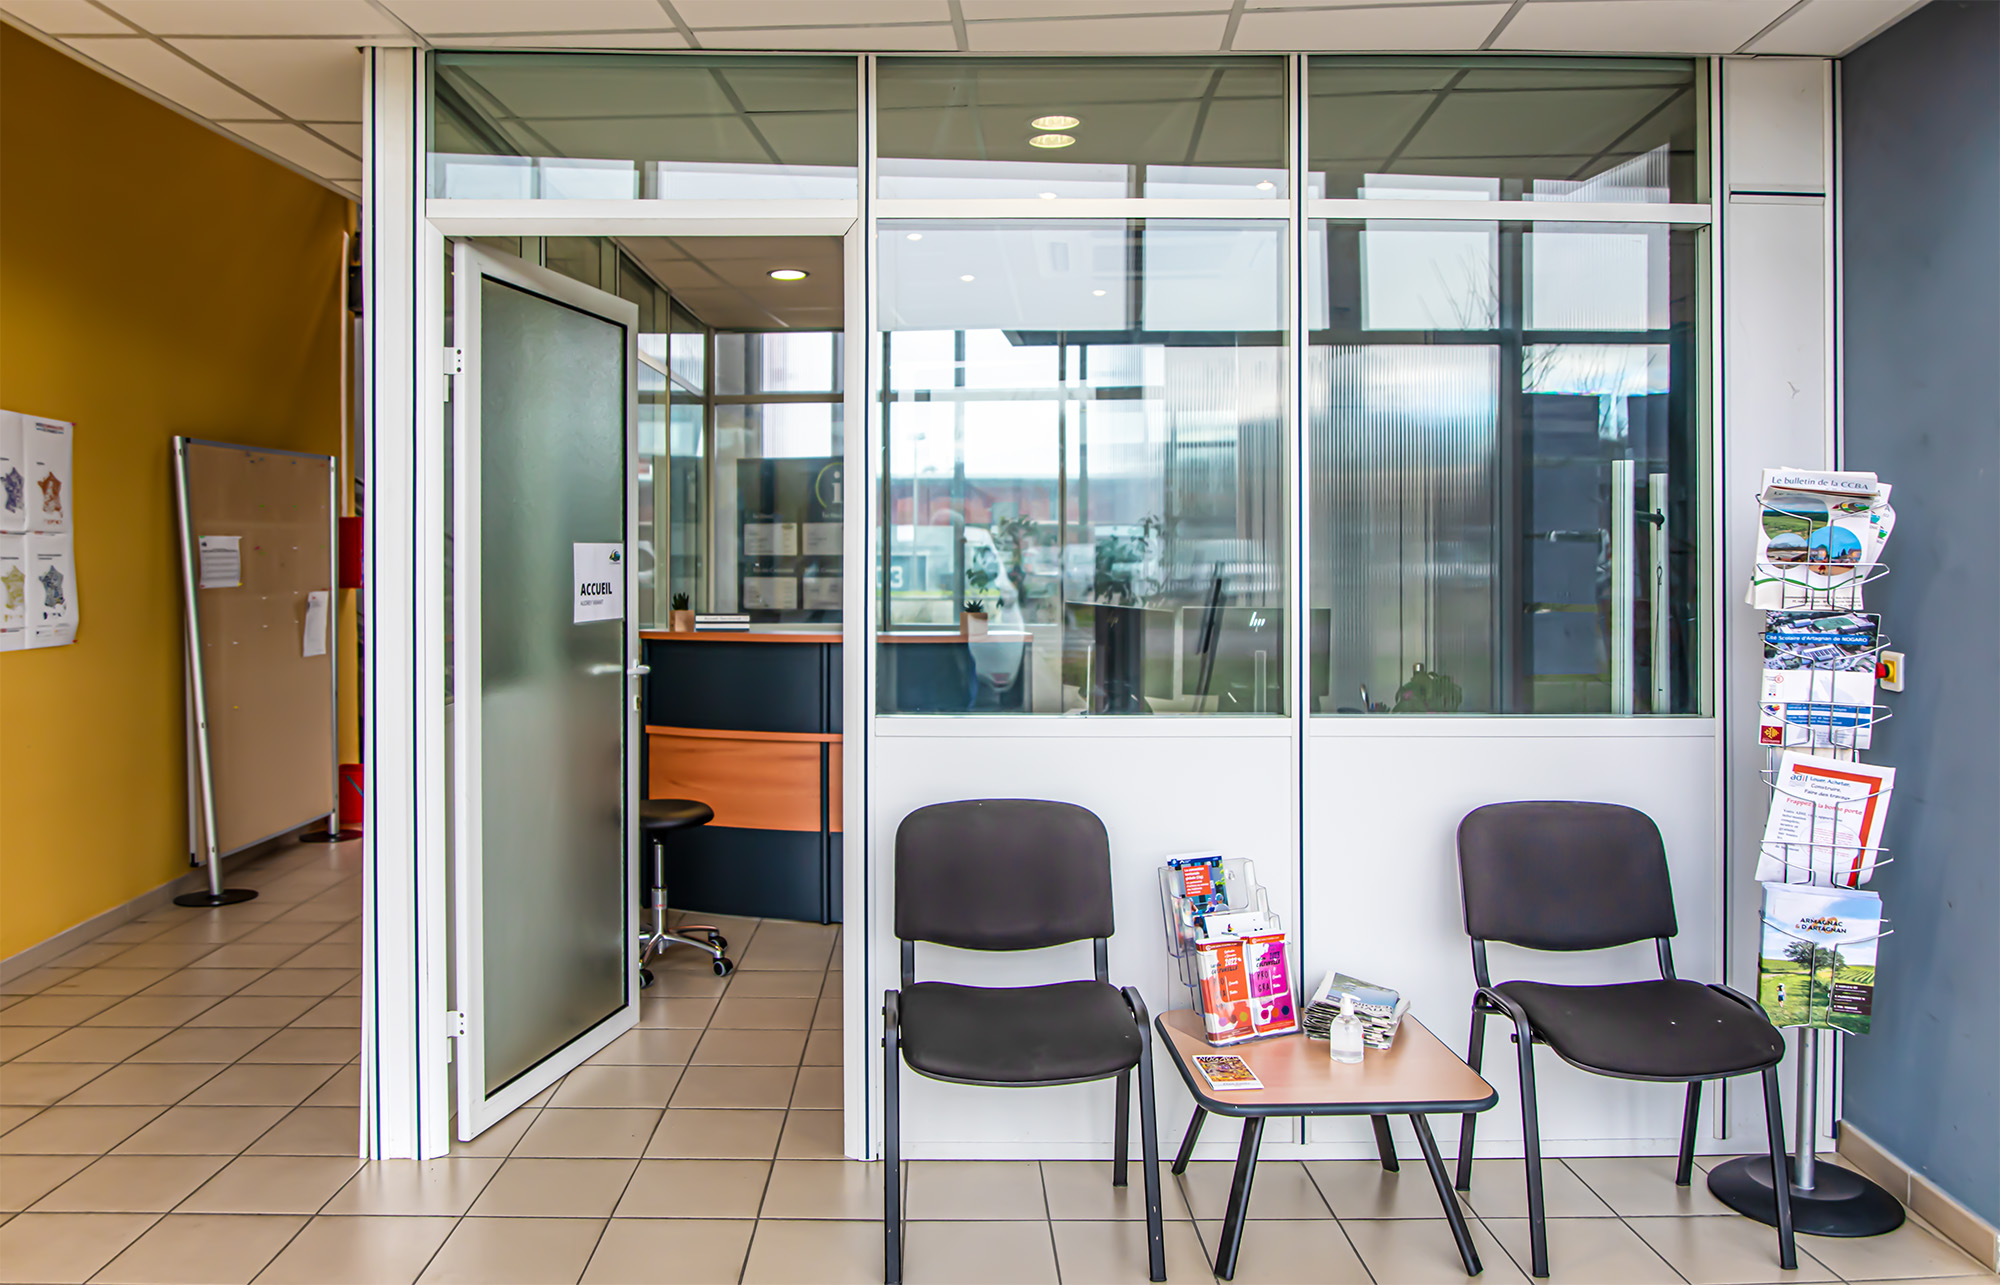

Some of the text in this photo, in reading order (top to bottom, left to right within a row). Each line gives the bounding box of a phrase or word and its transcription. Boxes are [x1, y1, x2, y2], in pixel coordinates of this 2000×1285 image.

[1772, 476, 1782, 484] Le
[1784, 477, 1816, 485] bulletin
[1840, 481, 1869, 490] CCBA
[580, 582, 613, 596] ACCUEIL
[1249, 611, 1266, 632] hp
[1786, 798, 1812, 806] Frappez
[1800, 917, 1843, 927] ARMAGNAC
[1257, 971, 1269, 980] PRO
